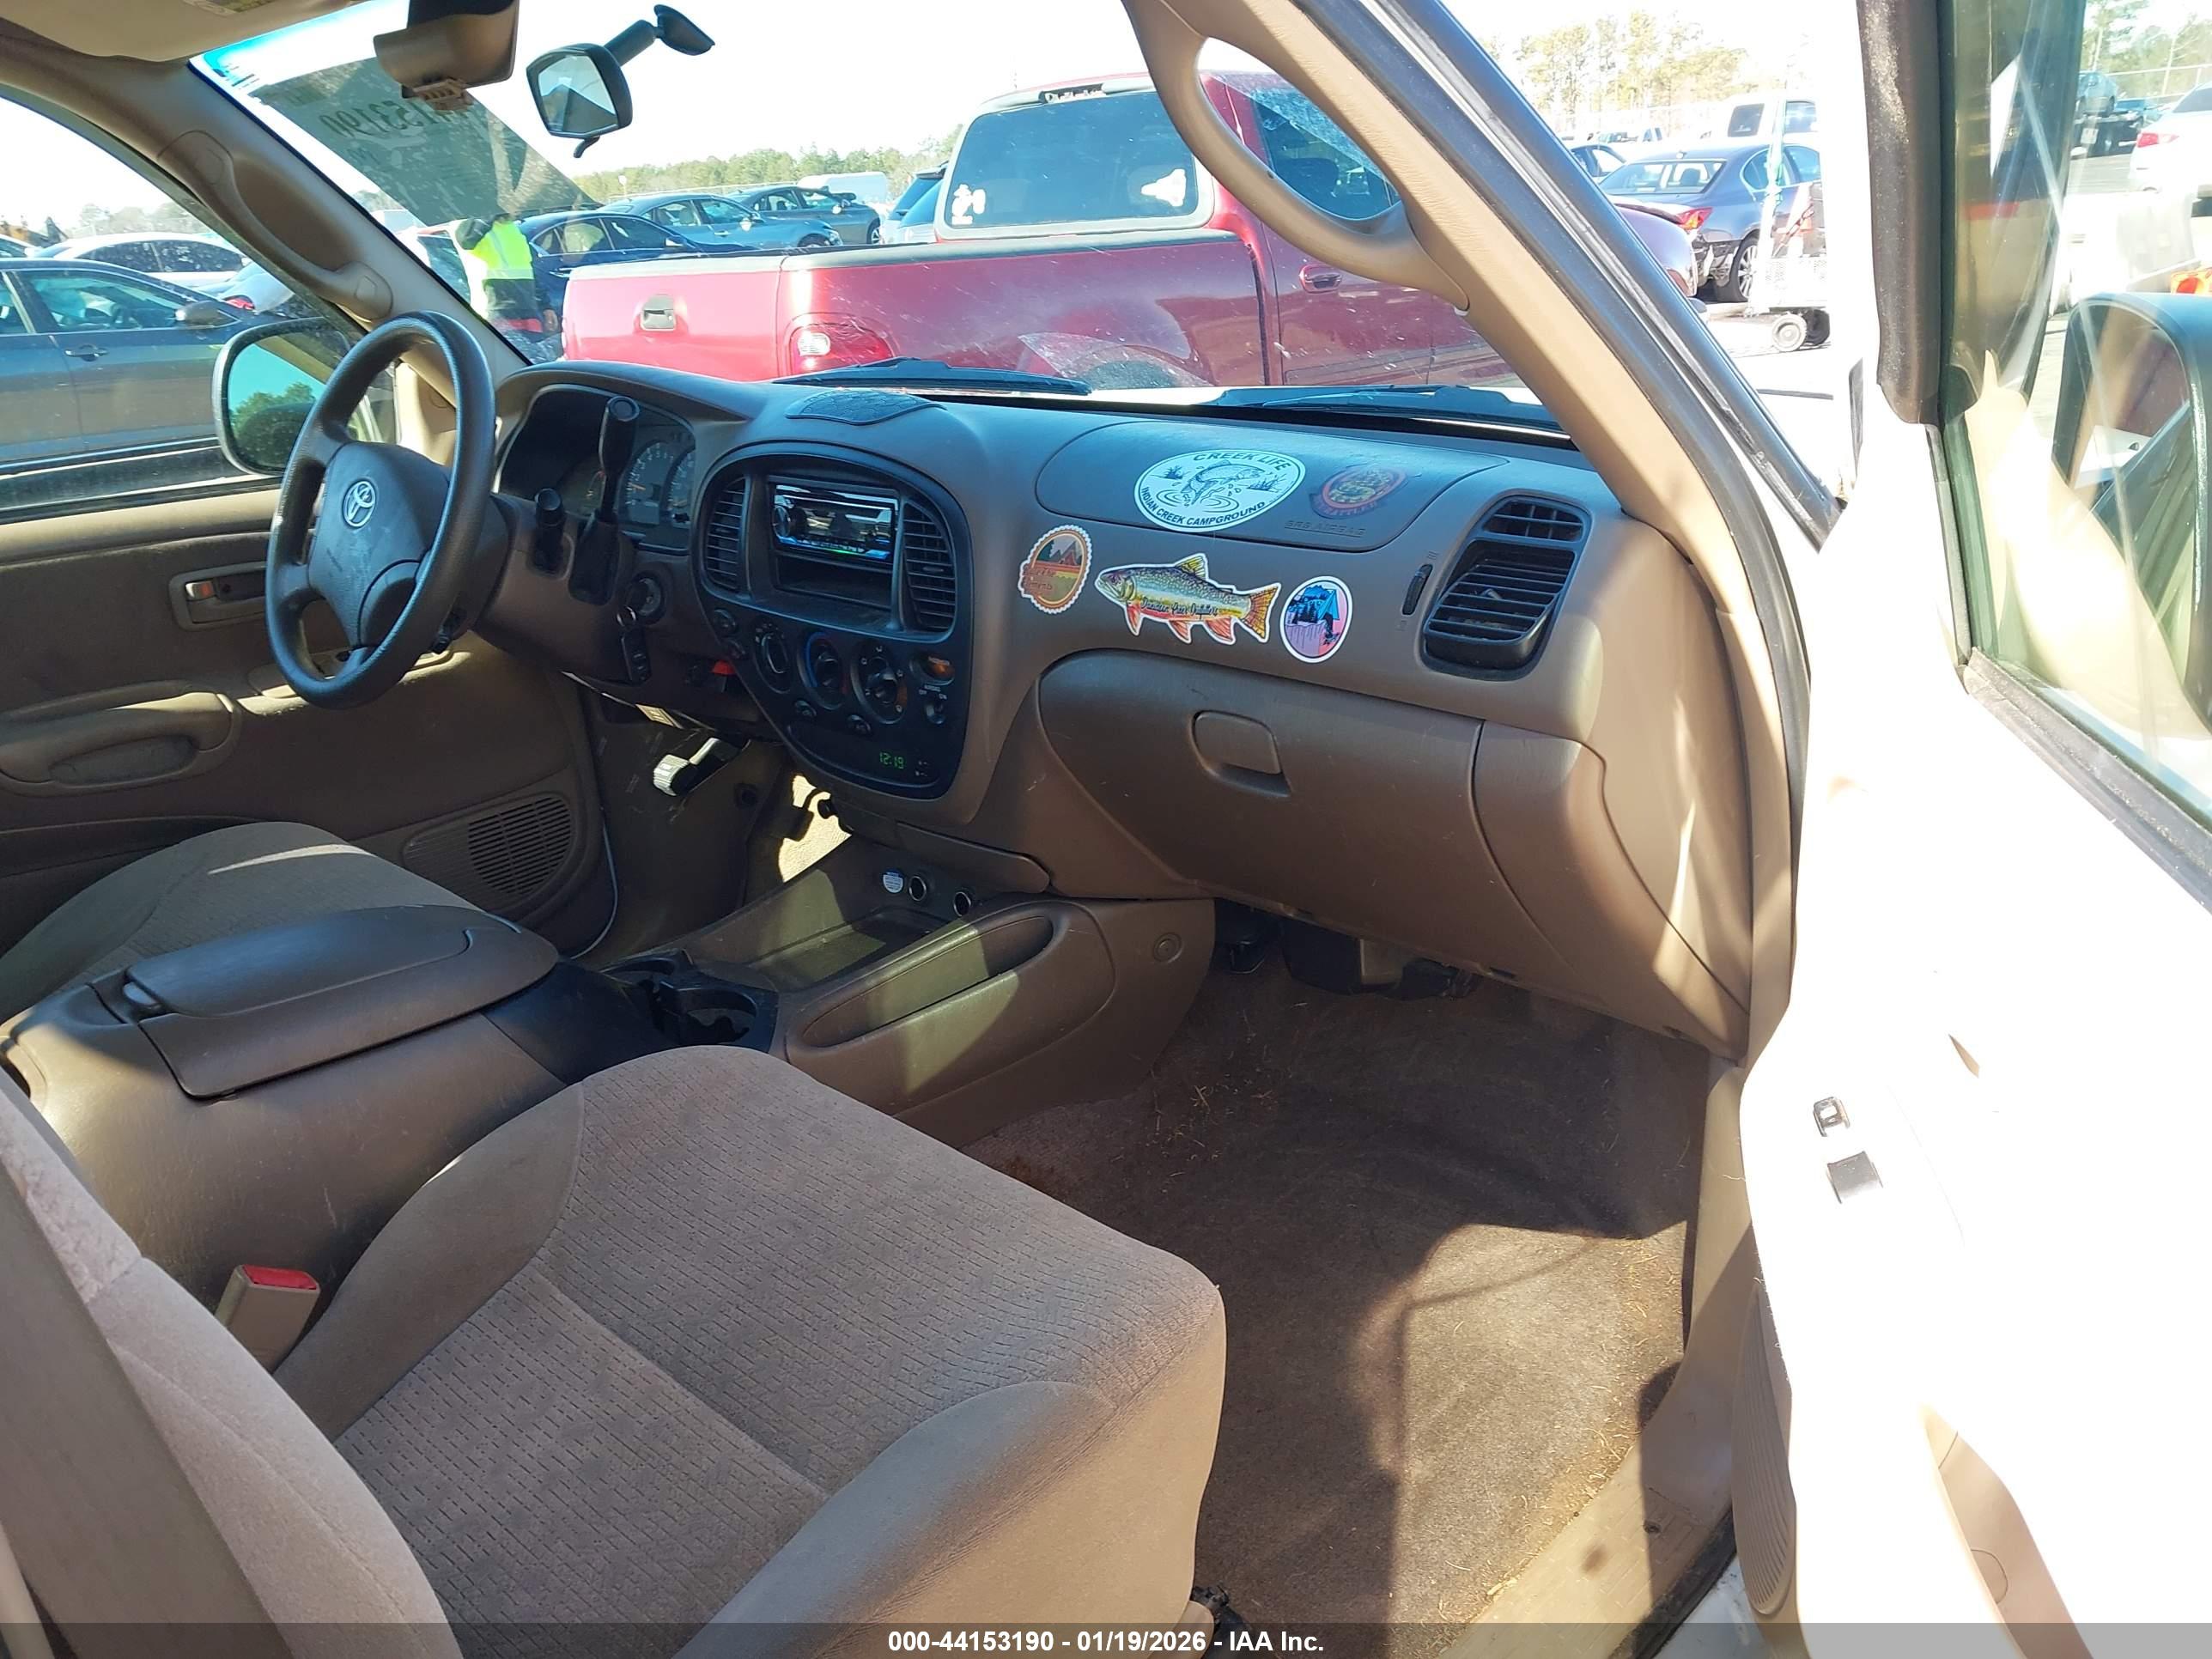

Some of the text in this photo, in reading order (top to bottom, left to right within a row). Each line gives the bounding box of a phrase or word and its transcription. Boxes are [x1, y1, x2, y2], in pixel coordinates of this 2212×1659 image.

[1193, 452, 1291, 471] CREEK LIFE
[1140, 486, 1266, 526] INDIAN CREEK CAMPGROUND
